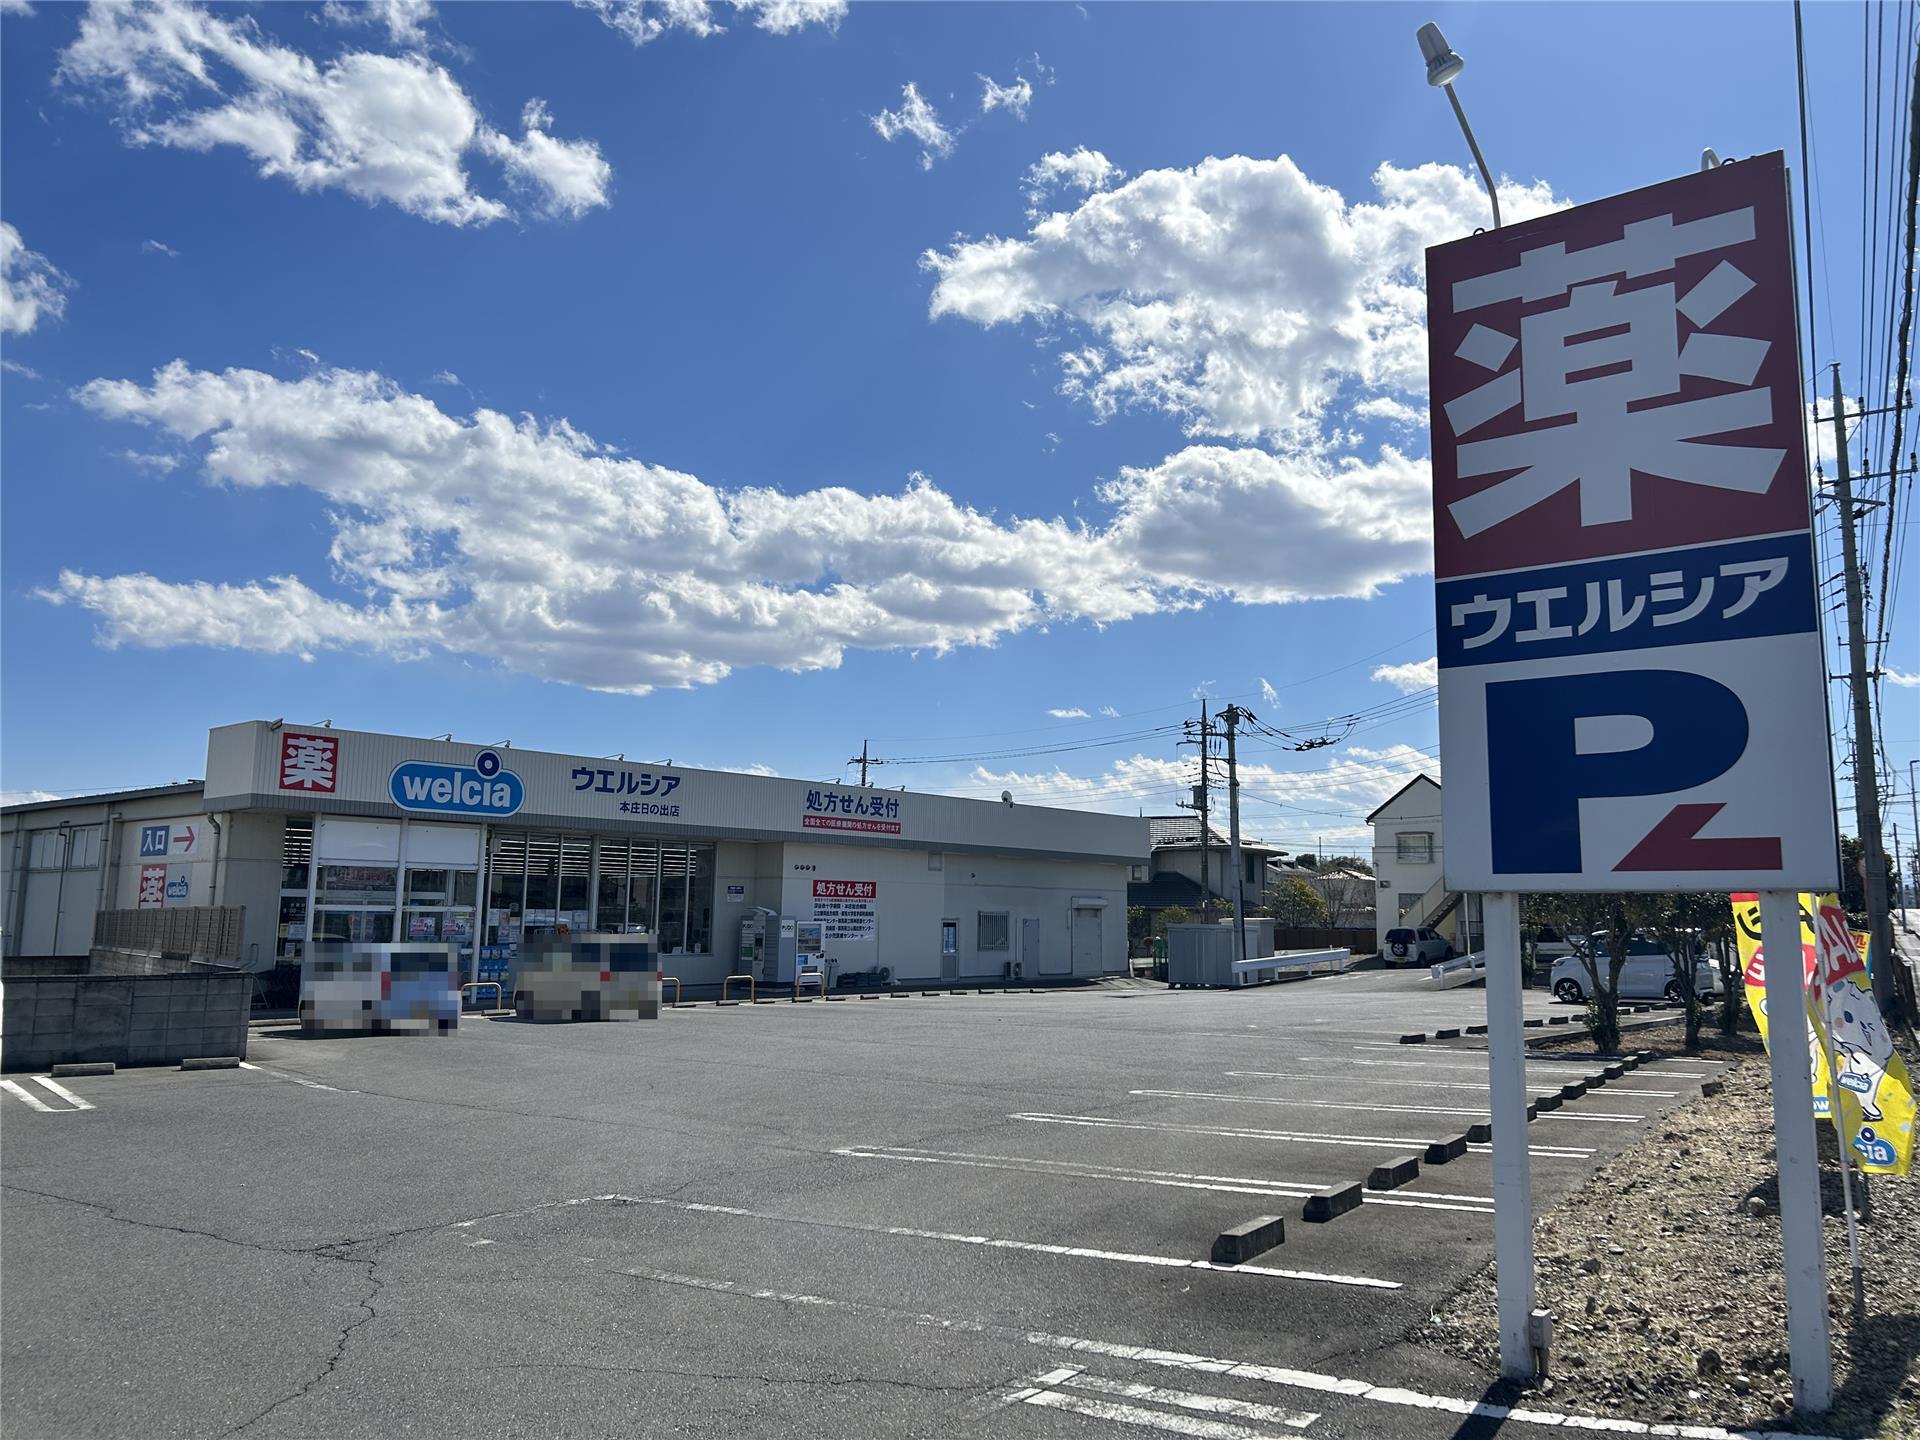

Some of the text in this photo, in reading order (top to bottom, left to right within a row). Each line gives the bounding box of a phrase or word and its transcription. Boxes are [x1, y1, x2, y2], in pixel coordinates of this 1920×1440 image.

[1444, 206, 1787, 540] 薬
[1451, 557, 1789, 649] ウエルシア
[283, 737, 335, 788] 薬
[402, 751, 512, 808] welcia
[571, 766, 681, 797] ウエルシア
[619, 801, 680, 818] 本庄日の出店
[806, 789, 900, 818] 処方せん受付
[142, 830, 167, 852] 入口
[140, 868, 165, 908] 薬
[816, 881, 873, 897] 処方せん受付
